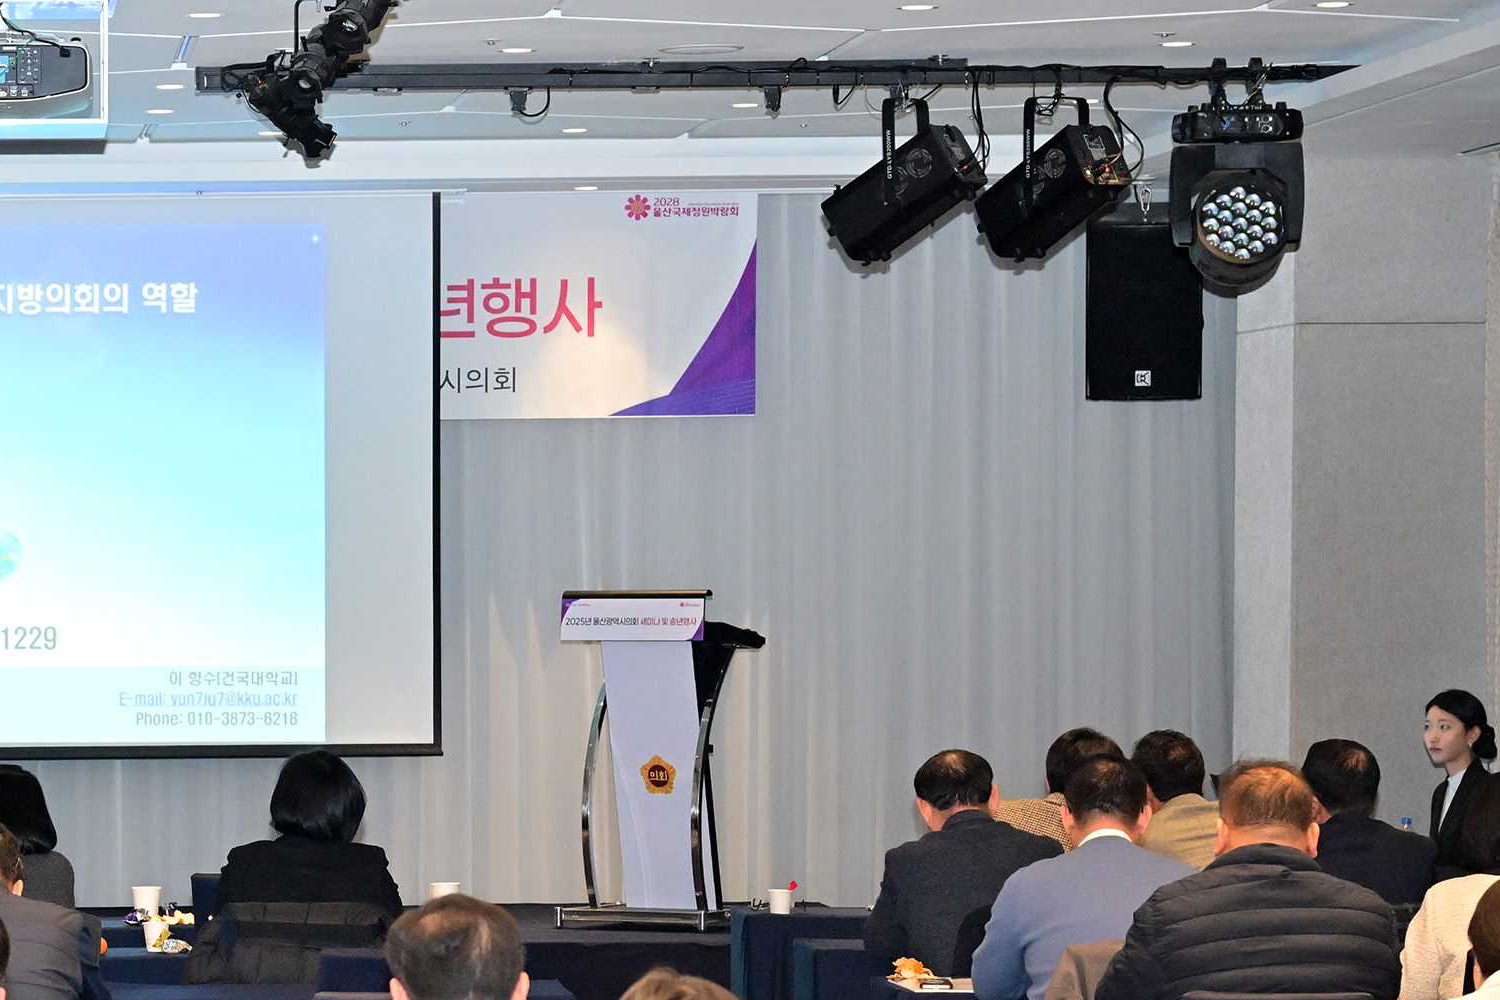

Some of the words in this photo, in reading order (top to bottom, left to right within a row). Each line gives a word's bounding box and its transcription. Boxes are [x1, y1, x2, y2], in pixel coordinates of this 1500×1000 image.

[653, 197, 680, 206] 2028
[653, 206, 739, 218] 울산국제정원박람회
[142, 281, 200, 314] 역할
[565, 617, 592, 627] 2025년
[592, 616, 639, 627] 울산광역시의회
[640, 616, 661, 627] 세미나
[661, 616, 669, 626] 및
[669, 616, 697, 627] 송년행사
[169, 671, 182, 687] 이
[119, 691, 166, 707] E-mail:
[136, 711, 183, 726] Phone:
[187, 711, 298, 726] 010-3873-6218
[649, 770, 668, 781] 의회
